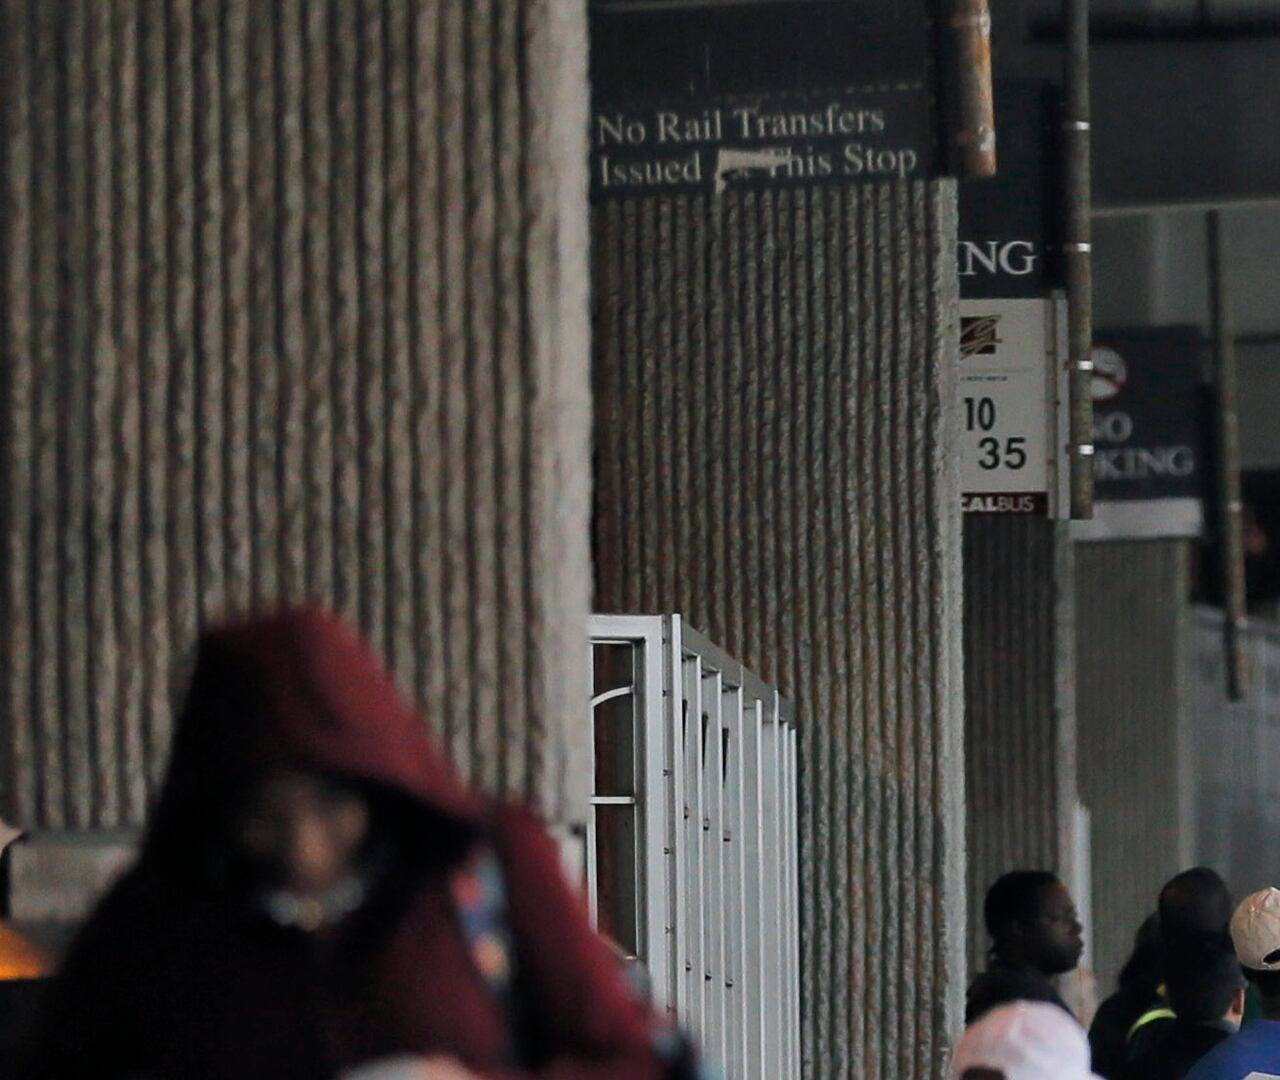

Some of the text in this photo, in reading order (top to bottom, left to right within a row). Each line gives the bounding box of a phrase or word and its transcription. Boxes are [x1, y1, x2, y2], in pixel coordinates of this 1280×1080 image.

[598, 103, 886, 145] No Rail Transfers
[601, 152, 701, 187] Issued
[844, 143, 917, 179] Stop
[963, 397, 996, 432] 10
[978, 437, 1028, 471] 35
